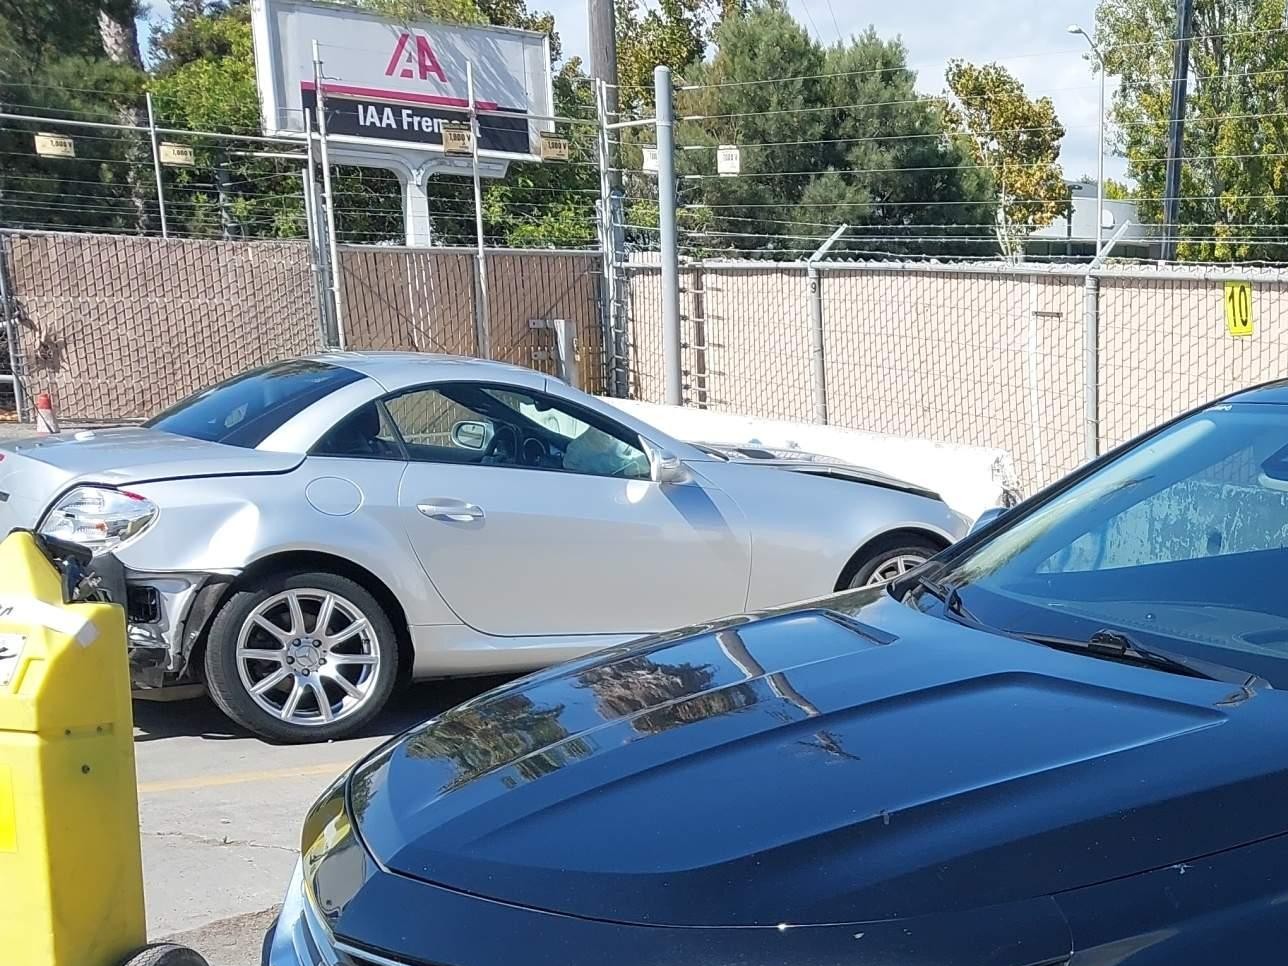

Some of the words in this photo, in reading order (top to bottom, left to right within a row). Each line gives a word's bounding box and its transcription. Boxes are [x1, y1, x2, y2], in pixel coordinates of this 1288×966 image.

[357, 104, 397, 130] IAA
[811, 281, 817, 294] 9
[1229, 285, 1248, 328] 10
